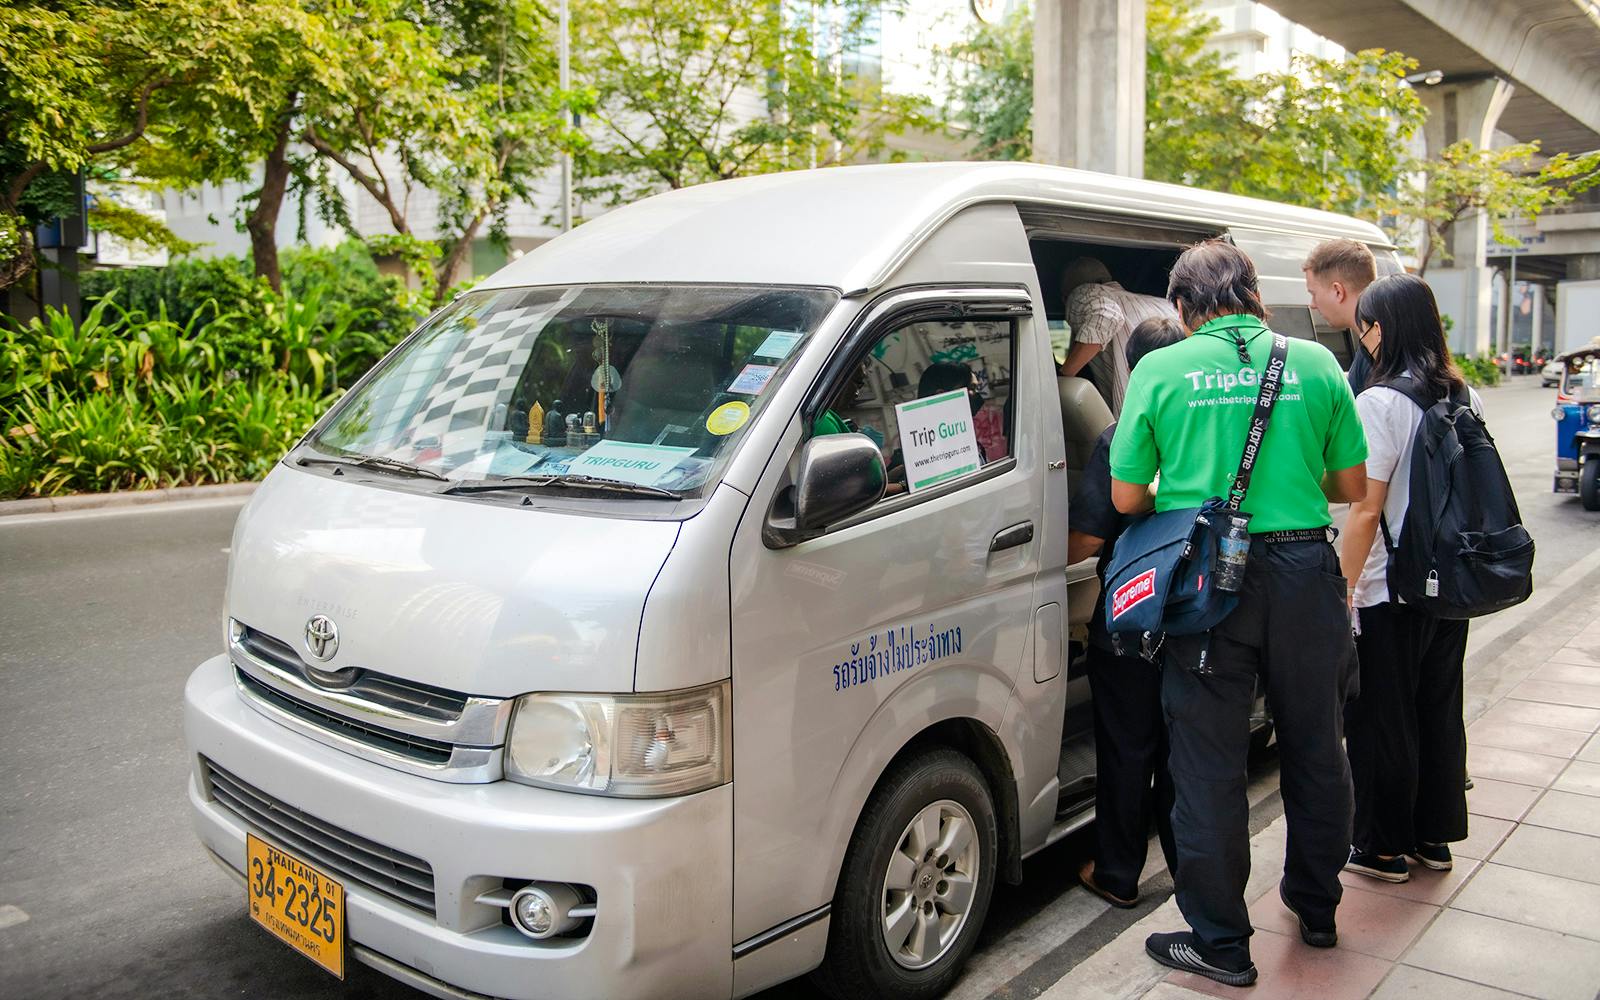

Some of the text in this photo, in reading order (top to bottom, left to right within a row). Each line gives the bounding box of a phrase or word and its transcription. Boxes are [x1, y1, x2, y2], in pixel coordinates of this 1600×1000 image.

[1184, 367, 1299, 392] TripGu
[910, 420, 967, 447] Trip Guru
[582, 455, 662, 471] TRIPGURU
[914, 445, 972, 468] www.thetripguru.com
[1113, 577, 1150, 611] Supreme
[833, 623, 962, 692] รถรับจ้างไม่ประจำทาง
[267, 847, 319, 886] THAILAND
[252, 856, 336, 944] 34-2325
